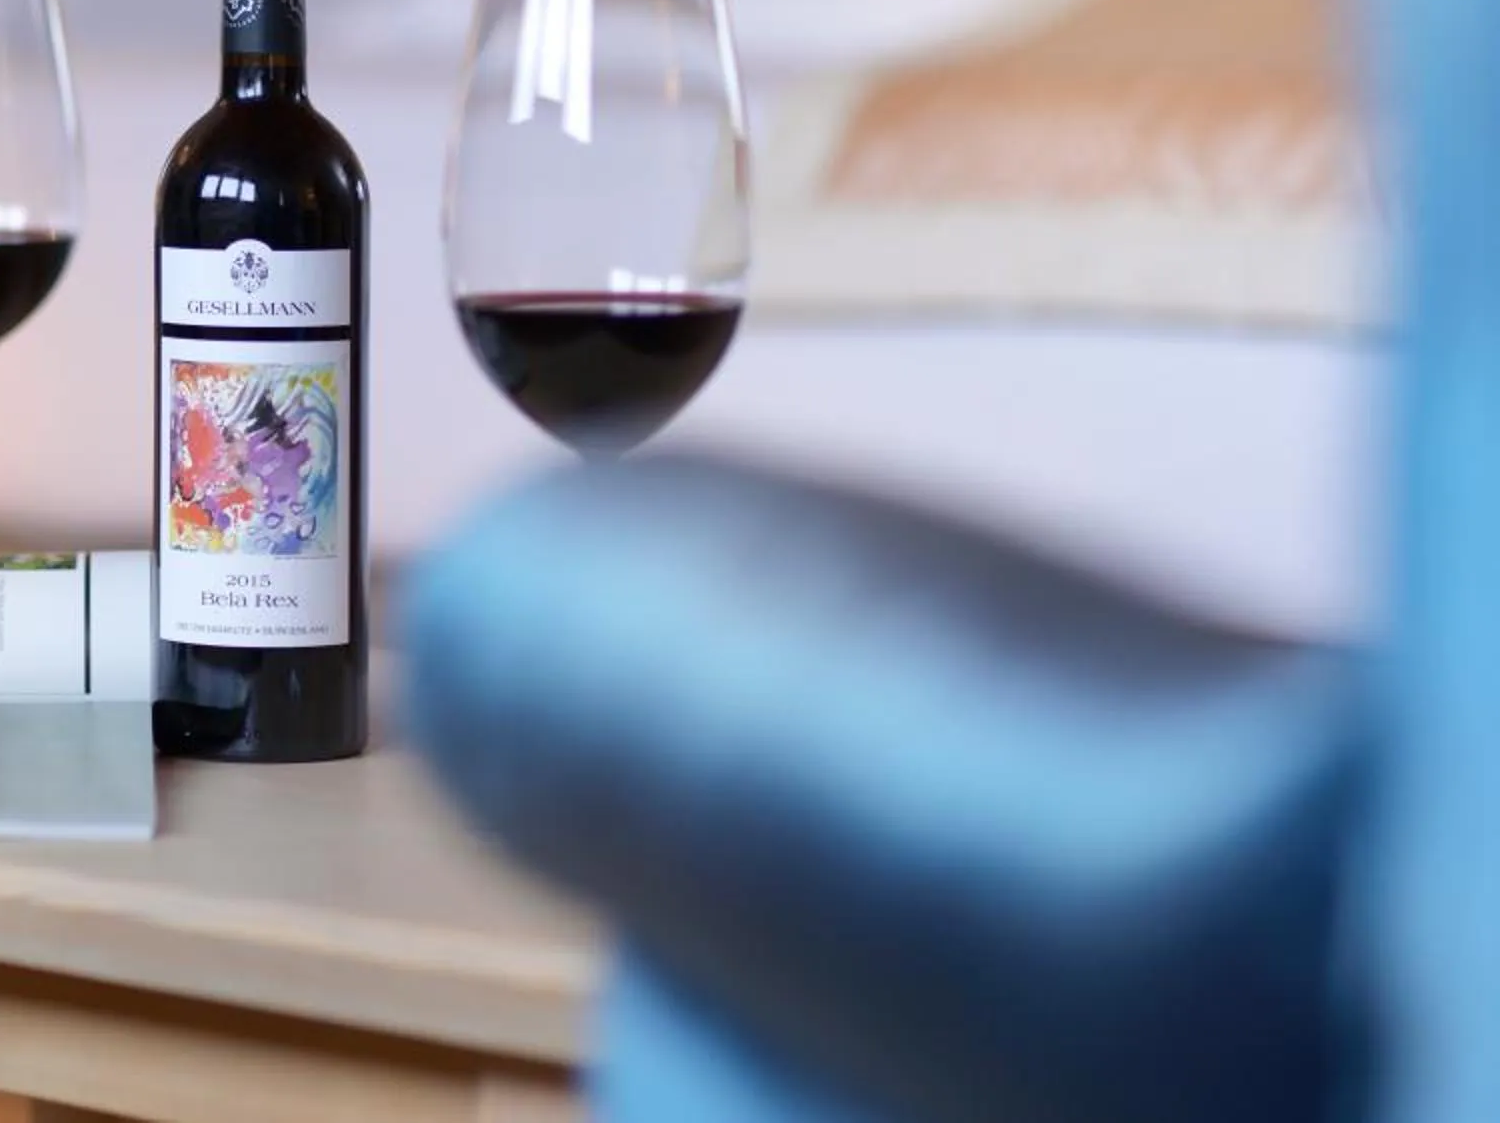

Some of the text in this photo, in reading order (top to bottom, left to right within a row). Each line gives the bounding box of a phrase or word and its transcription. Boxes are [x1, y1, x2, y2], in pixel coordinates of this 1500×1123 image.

[187, 300, 317, 317] GESELLMANN
[225, 574, 272, 588] 2015
[255, 592, 300, 609] Rex
